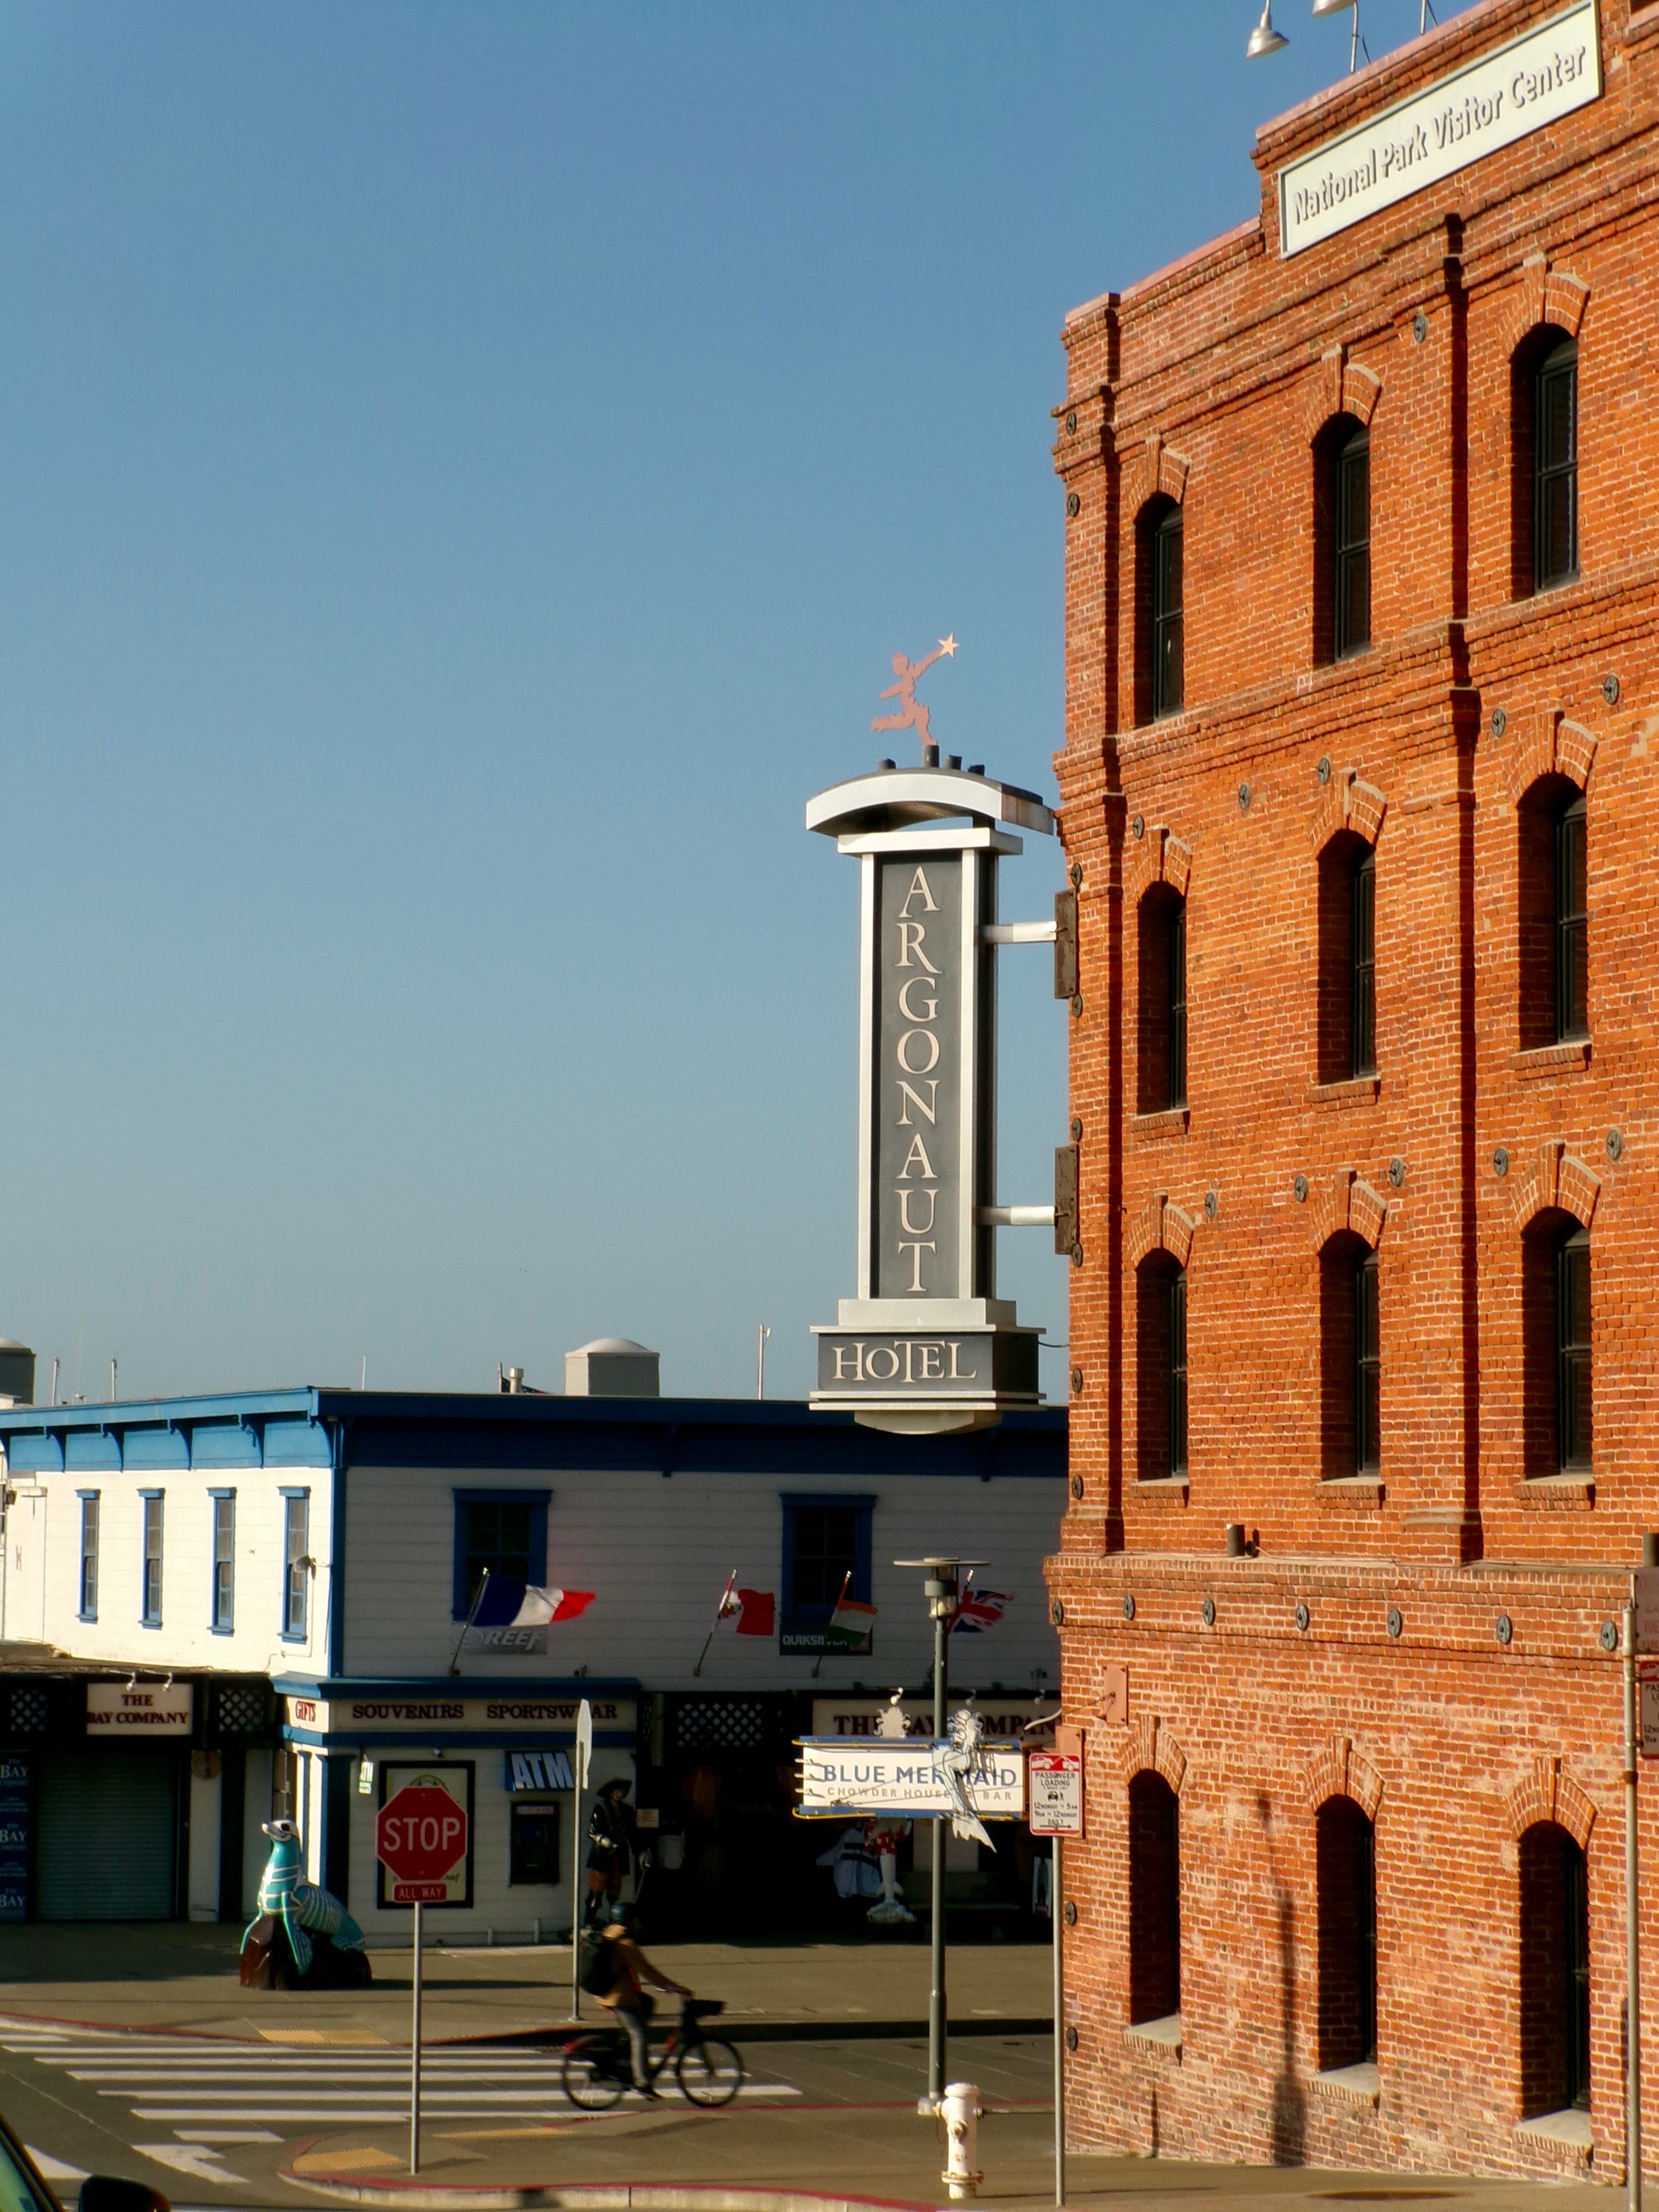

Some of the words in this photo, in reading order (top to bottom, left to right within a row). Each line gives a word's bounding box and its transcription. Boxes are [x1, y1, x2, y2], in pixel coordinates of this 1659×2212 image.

[1294, 148, 1377, 225] National
[1382, 124, 1429, 178] Park
[1433, 90, 1503, 149] Visitor
[1509, 46, 1586, 108] Center
[894, 865, 943, 1292] ARGONAUT
[831, 1340, 977, 1383] HOTEL
[121, 1694, 154, 1706] THE
[87, 1712, 113, 1723] BAY
[116, 1712, 189, 1724] COMPANY
[295, 1700, 316, 1722] GIFTS
[352, 1705, 464, 1719] SOUVENIRS
[486, 1704, 618, 1720] SPORTSWAR
[0, 1765, 28, 1778] BAY
[511, 1752, 575, 1789] ATM
[824, 1765, 885, 1783] BLUE
[827, 1787, 897, 1798] CHOWDER
[983, 1791, 1012, 1801] BAR
[0, 1829, 27, 1843] BAY
[383, 1816, 461, 1852] STOP
[398, 1887, 418, 1899] ALL
[422, 1887, 442, 1898] WAY
